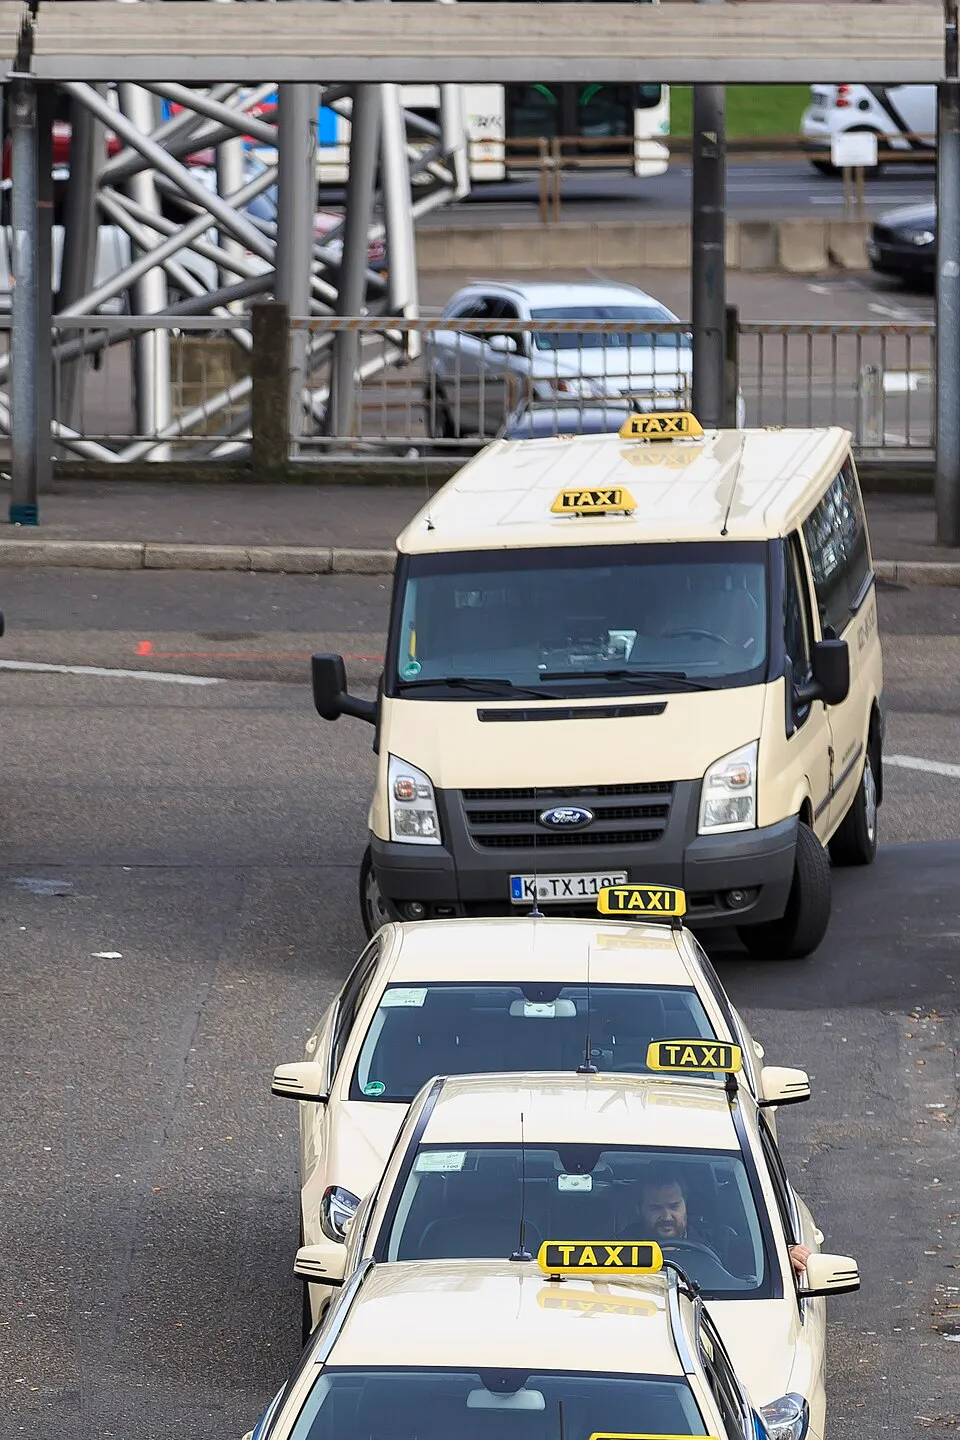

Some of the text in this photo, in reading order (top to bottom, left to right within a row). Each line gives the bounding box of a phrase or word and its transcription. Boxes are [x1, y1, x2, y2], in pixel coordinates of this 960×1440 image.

[632, 418, 687, 433] TAXI
[564, 491, 620, 506] TAXI
[524, 880, 535, 897] K
[614, 891, 670, 910] TAXI
[665, 1046, 726, 1067] TAXI
[558, 1246, 639, 1266] TAXI
